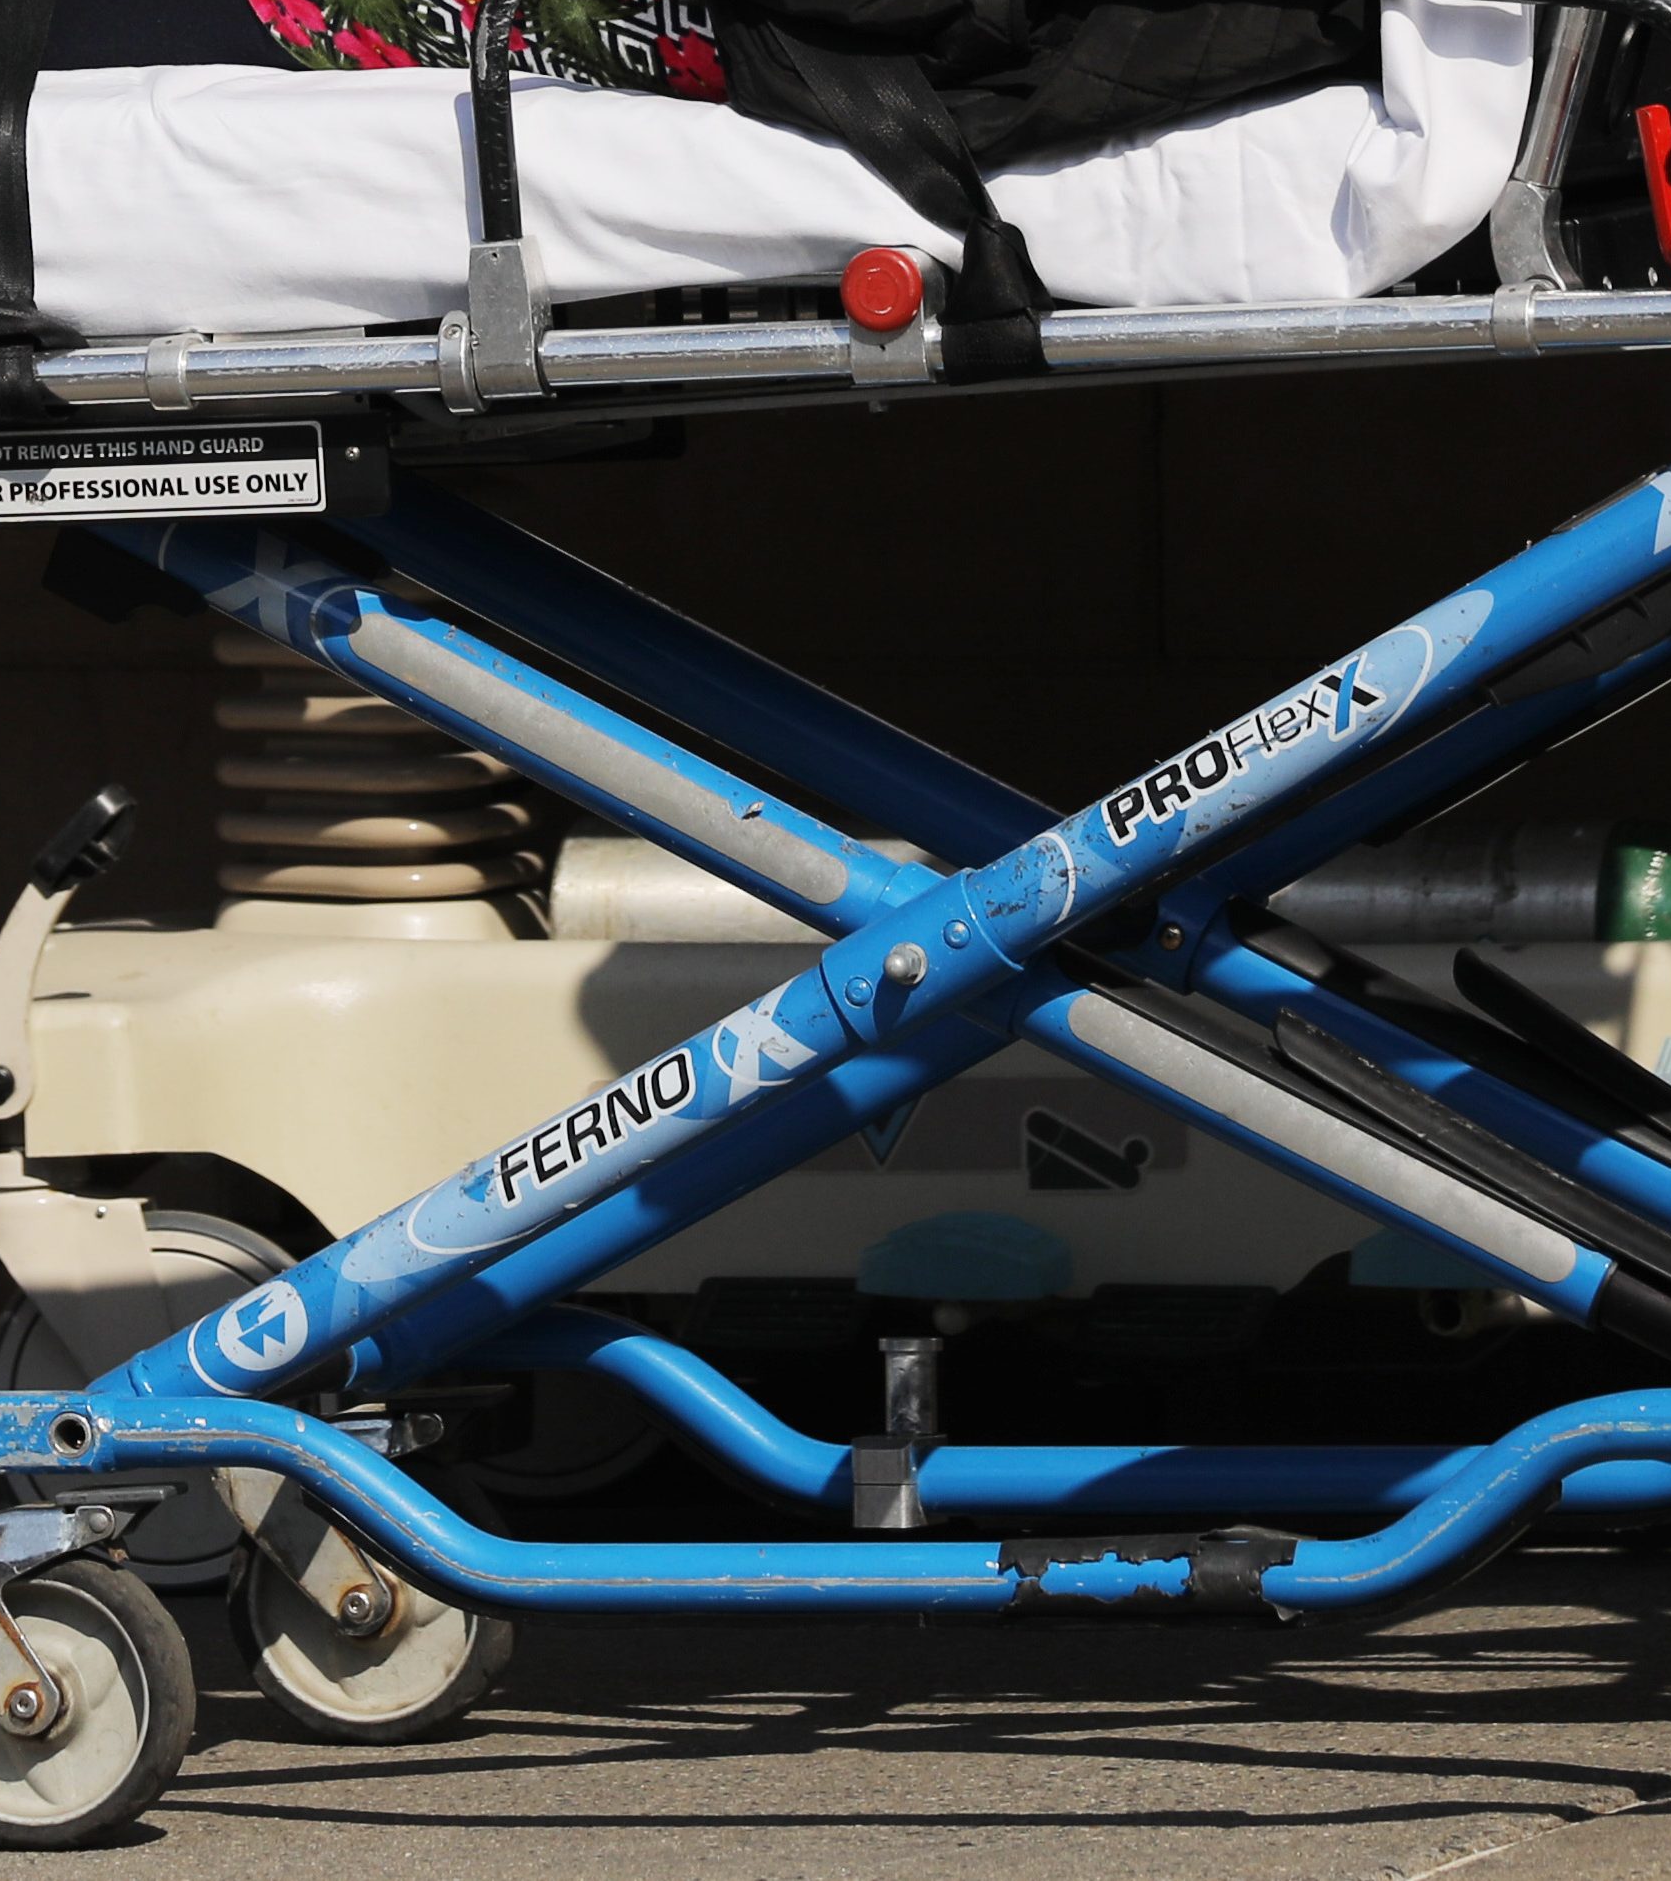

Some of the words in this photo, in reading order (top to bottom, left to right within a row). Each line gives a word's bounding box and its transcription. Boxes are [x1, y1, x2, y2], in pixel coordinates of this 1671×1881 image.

[17, 443, 94, 460] REMOVE
[96, 441, 138, 458] THIS
[141, 439, 196, 456] HAND
[199, 436, 265, 455] GUARD
[9, 477, 190, 502] PROFESSIONAL
[195, 475, 240, 495] USE
[245, 472, 309, 495] ONLY
[499, 1052, 691, 1204] FERNO
